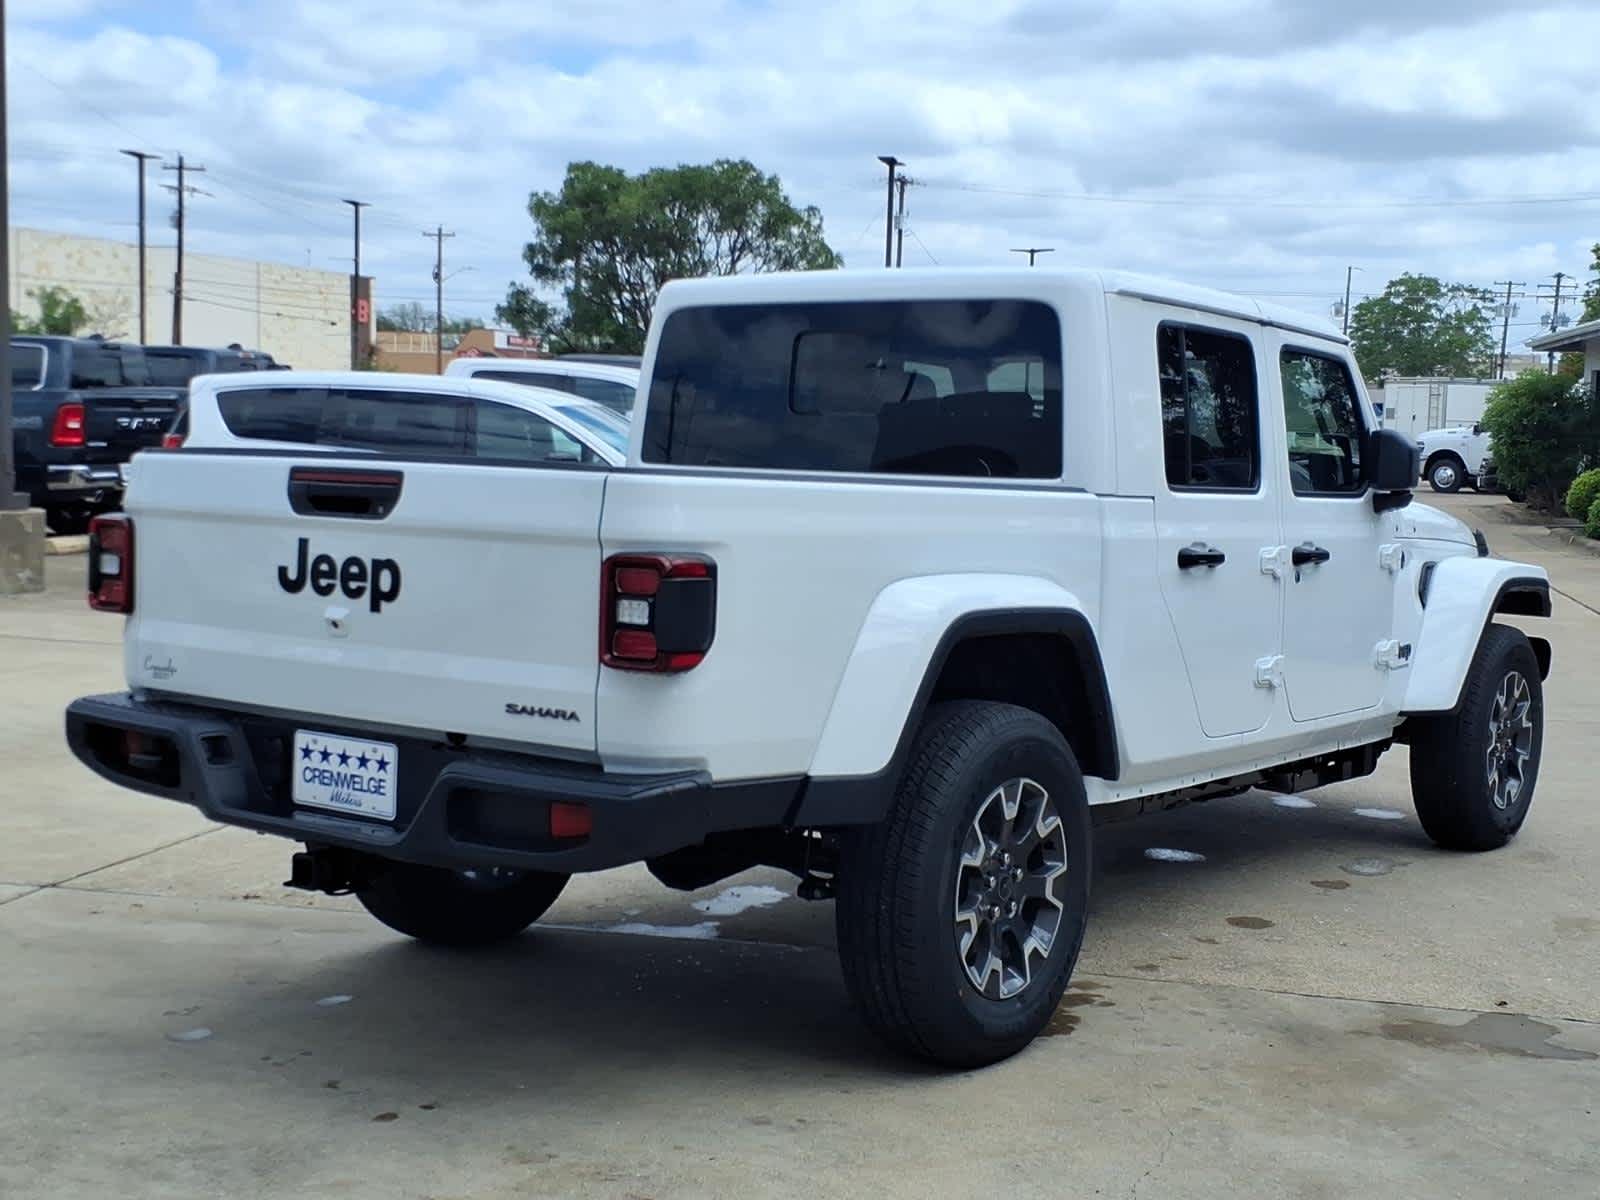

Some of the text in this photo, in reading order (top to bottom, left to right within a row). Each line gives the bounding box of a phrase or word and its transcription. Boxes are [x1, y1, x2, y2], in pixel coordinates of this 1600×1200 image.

[278, 537, 401, 613] Jeep
[505, 703, 581, 722] SAHARA
[303, 766, 387, 796] CRENWELGE
